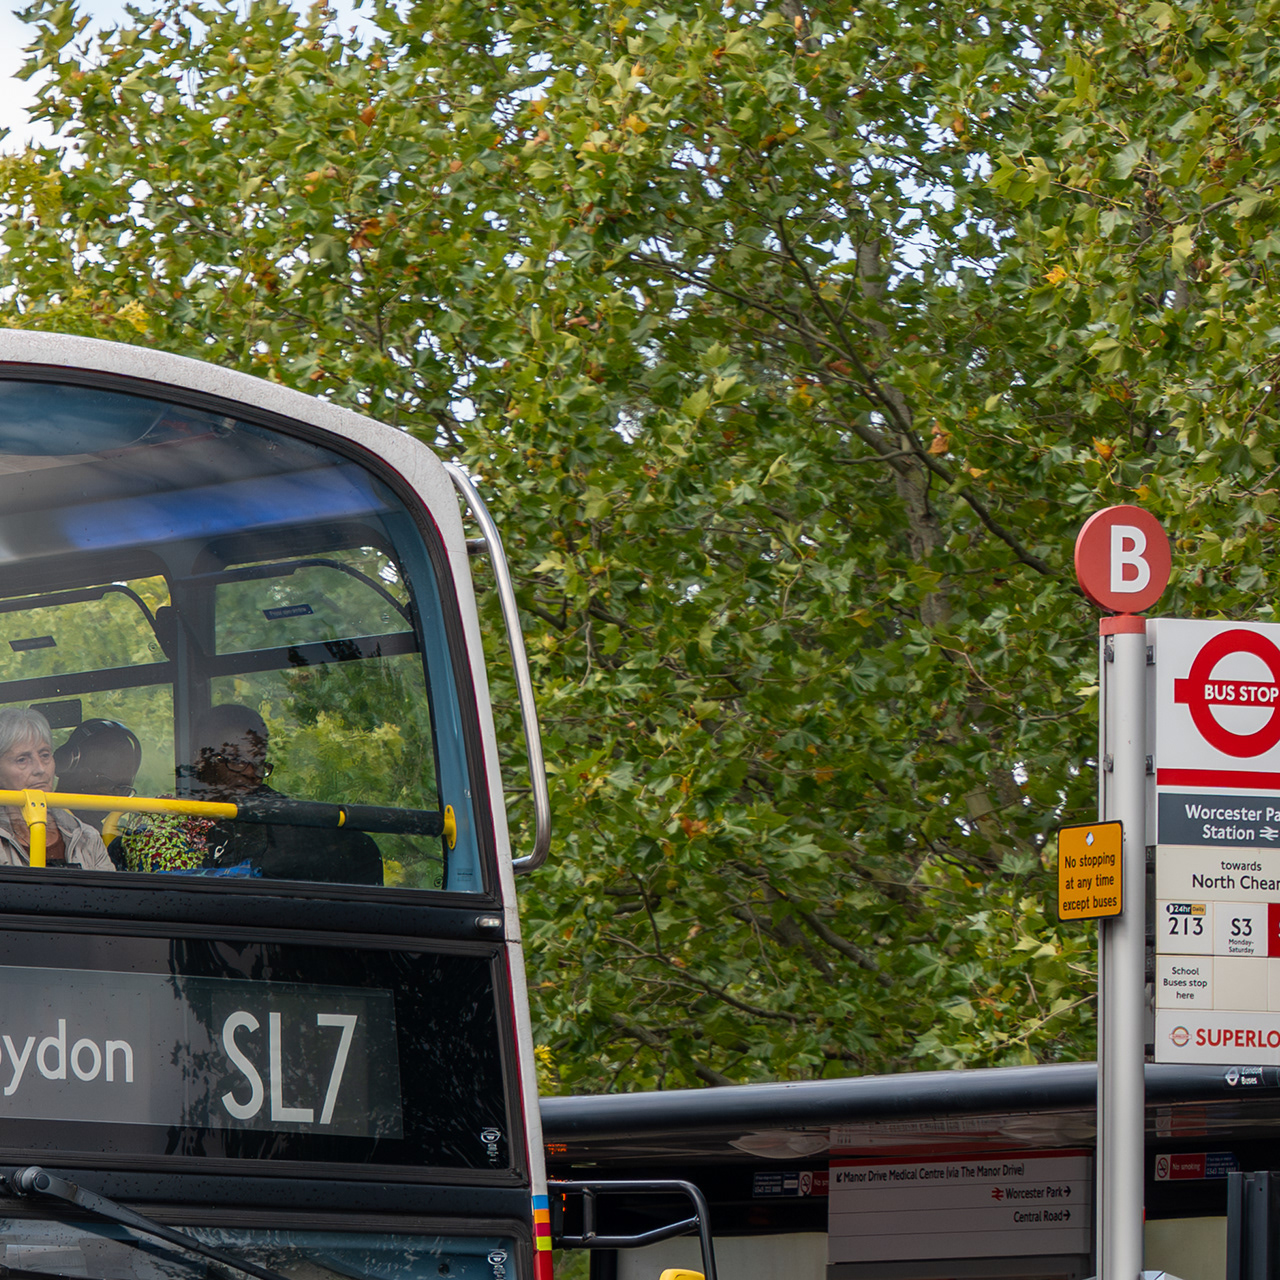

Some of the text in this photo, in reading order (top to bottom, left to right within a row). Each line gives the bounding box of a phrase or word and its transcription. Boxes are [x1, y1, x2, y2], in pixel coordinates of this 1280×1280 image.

[1110, 524, 1150, 593] B
[1204, 684, 1279, 702] BUS STOP
[1185, 804, 1262, 821] Worcester
[1202, 824, 1255, 840] Station
[1065, 852, 1115, 868] No stopping
[1221, 861, 1262, 871] towards
[1066, 874, 1114, 890] at any time
[1192, 874, 1235, 889] North
[1063, 896, 1117, 912] except buses
[1174, 904, 1191, 913] 24hr
[1168, 917, 1204, 936] 213
[1231, 918, 1253, 936] S3
[1228, 939, 1254, 947] Monday-
[1228, 946, 1254, 955] Saturday
[1171, 967, 1200, 975] School
[1163, 978, 1208, 989] Buses stop
[1176, 991, 1195, 1000] here
[221, 1010, 358, 1125] SL7
[843, 1172, 867, 1183] Manor
[868, 1170, 888, 1182] Drive
[889, 1169, 917, 1181] Medical
[919, 1167, 945, 1179] Centre
[946, 1166, 959, 1180] (via
[961, 1166, 975, 1178] The
[977, 1165, 1001, 1177] Manor
[1003, 1163, 1025, 1177] Drive)
[1005, 1187, 1063, 1199] Worcester Park
[1014, 1210, 1063, 1223] Central Road
